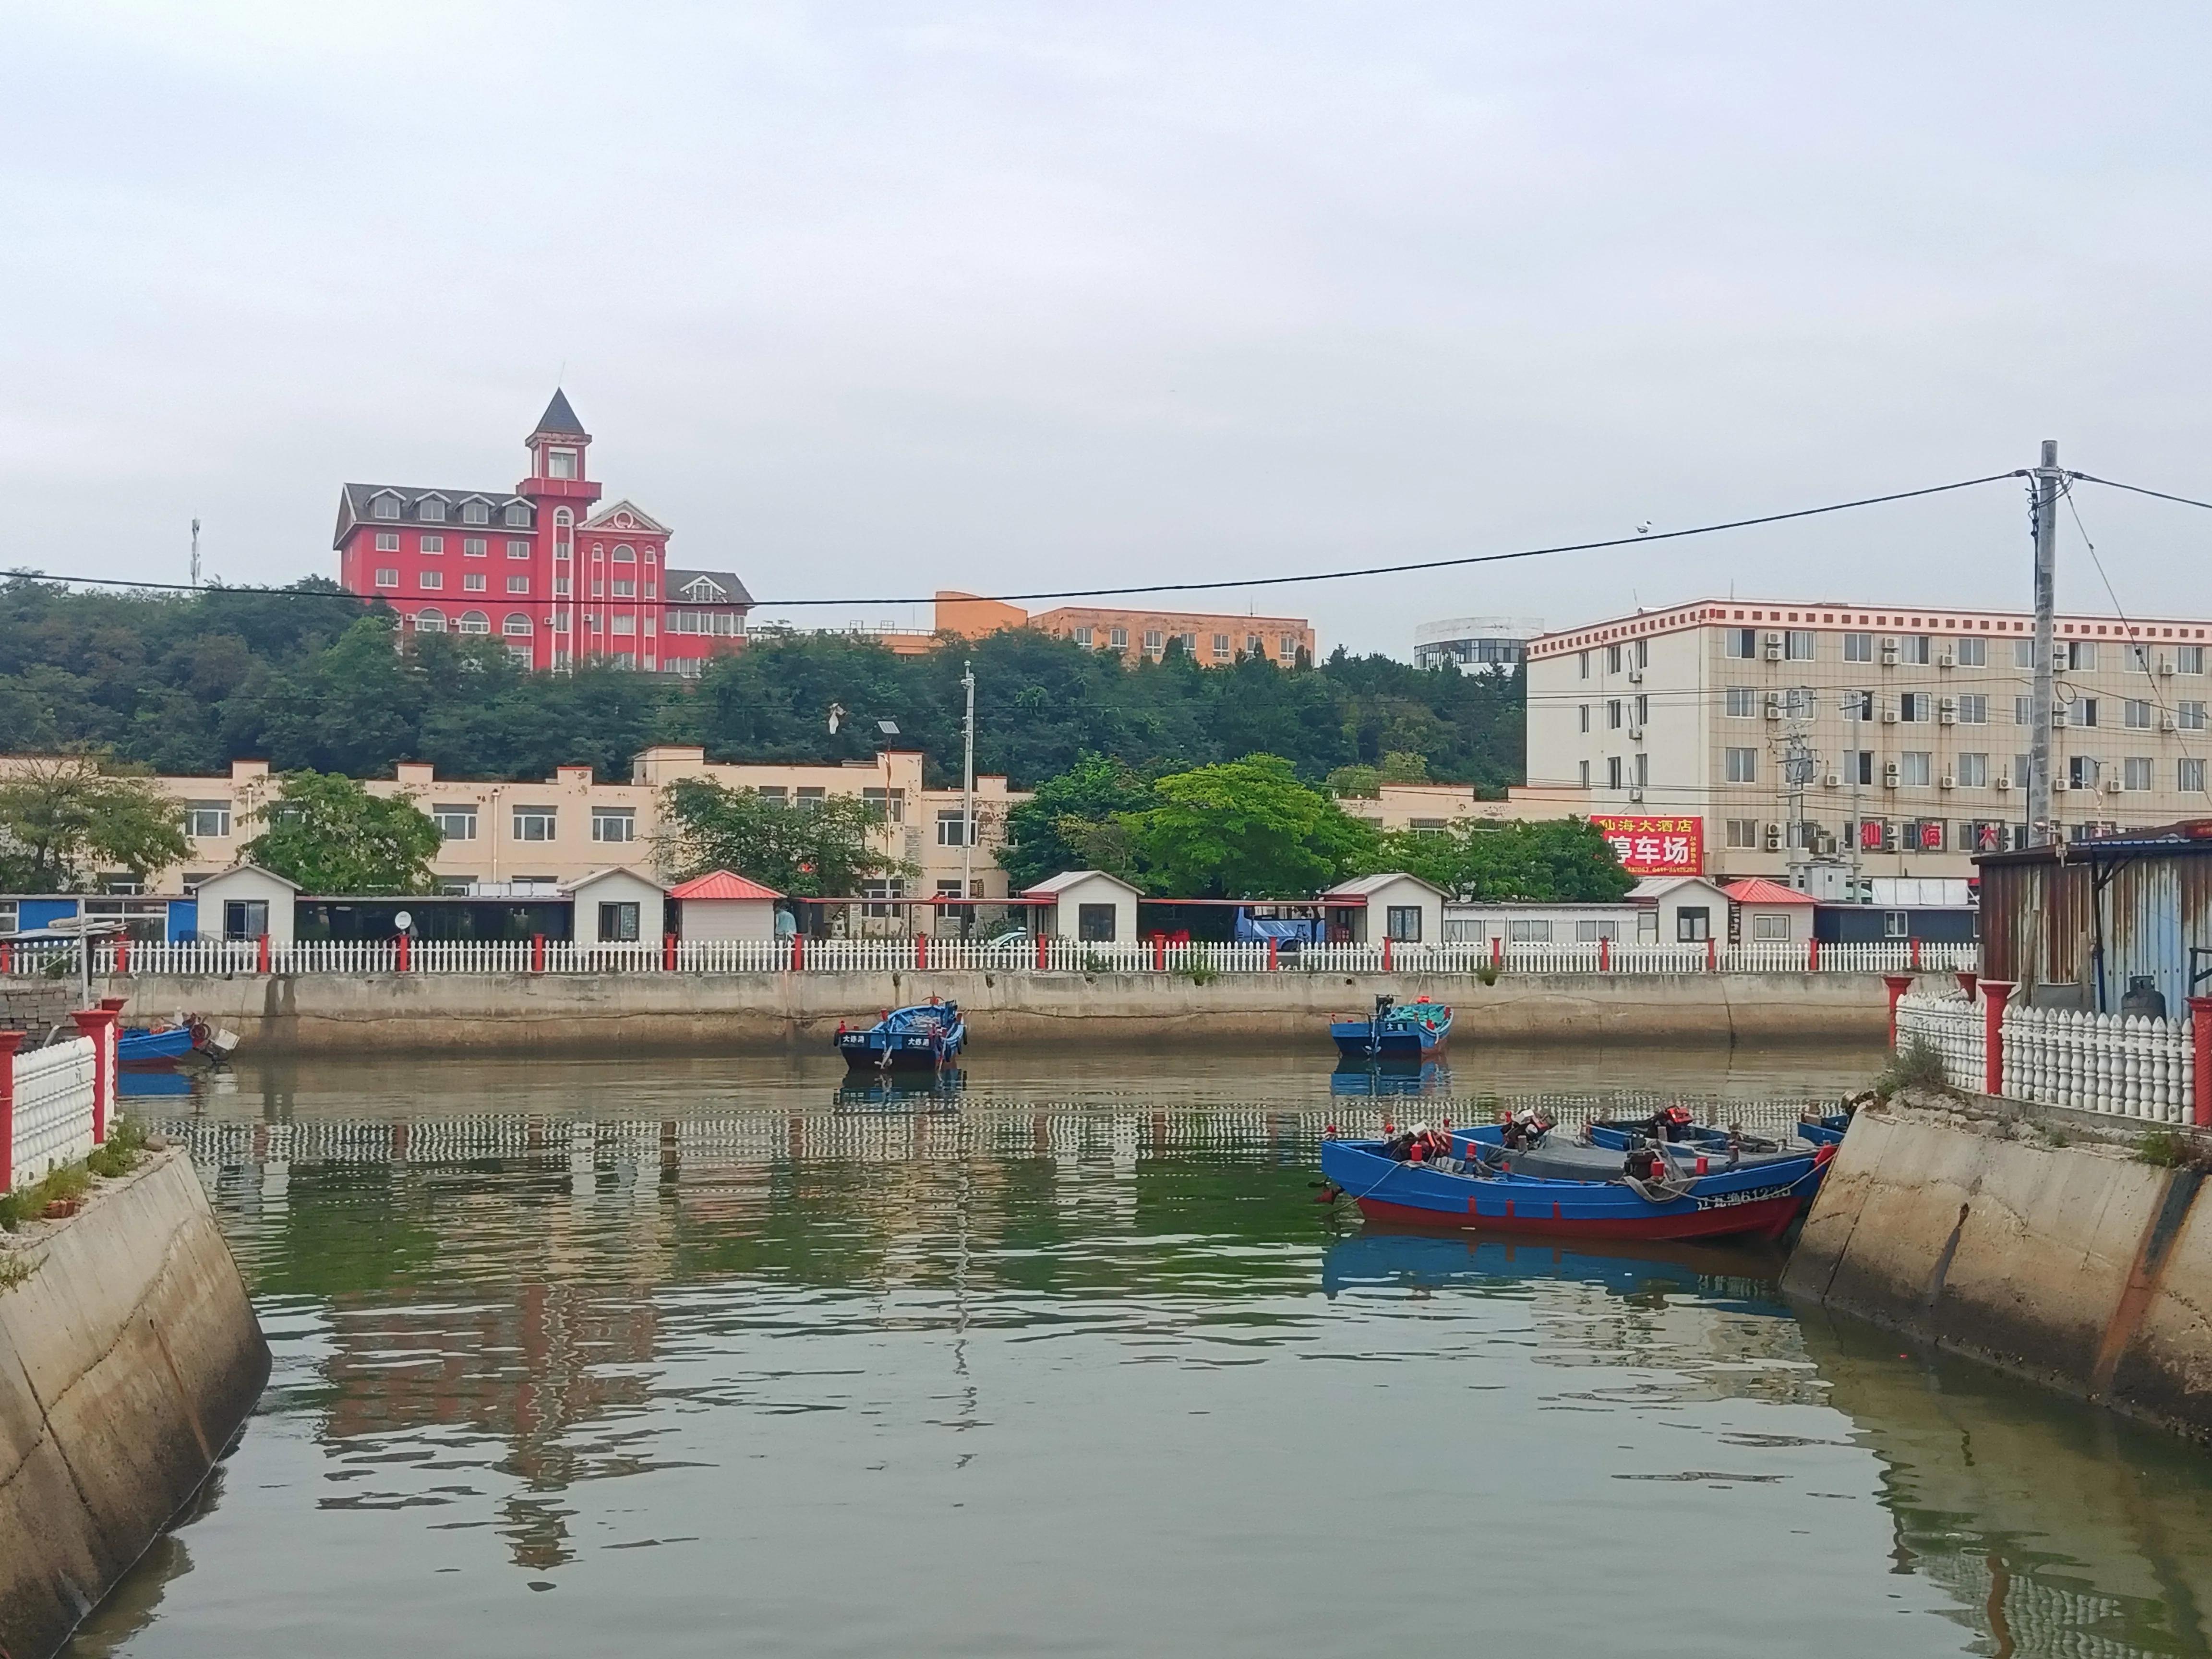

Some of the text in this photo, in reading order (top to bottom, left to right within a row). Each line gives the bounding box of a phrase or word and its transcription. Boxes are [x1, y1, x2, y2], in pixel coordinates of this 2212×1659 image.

[1599, 819, 1694, 833] 仙海大酒店
[1608, 835, 1689, 865] 停车场
